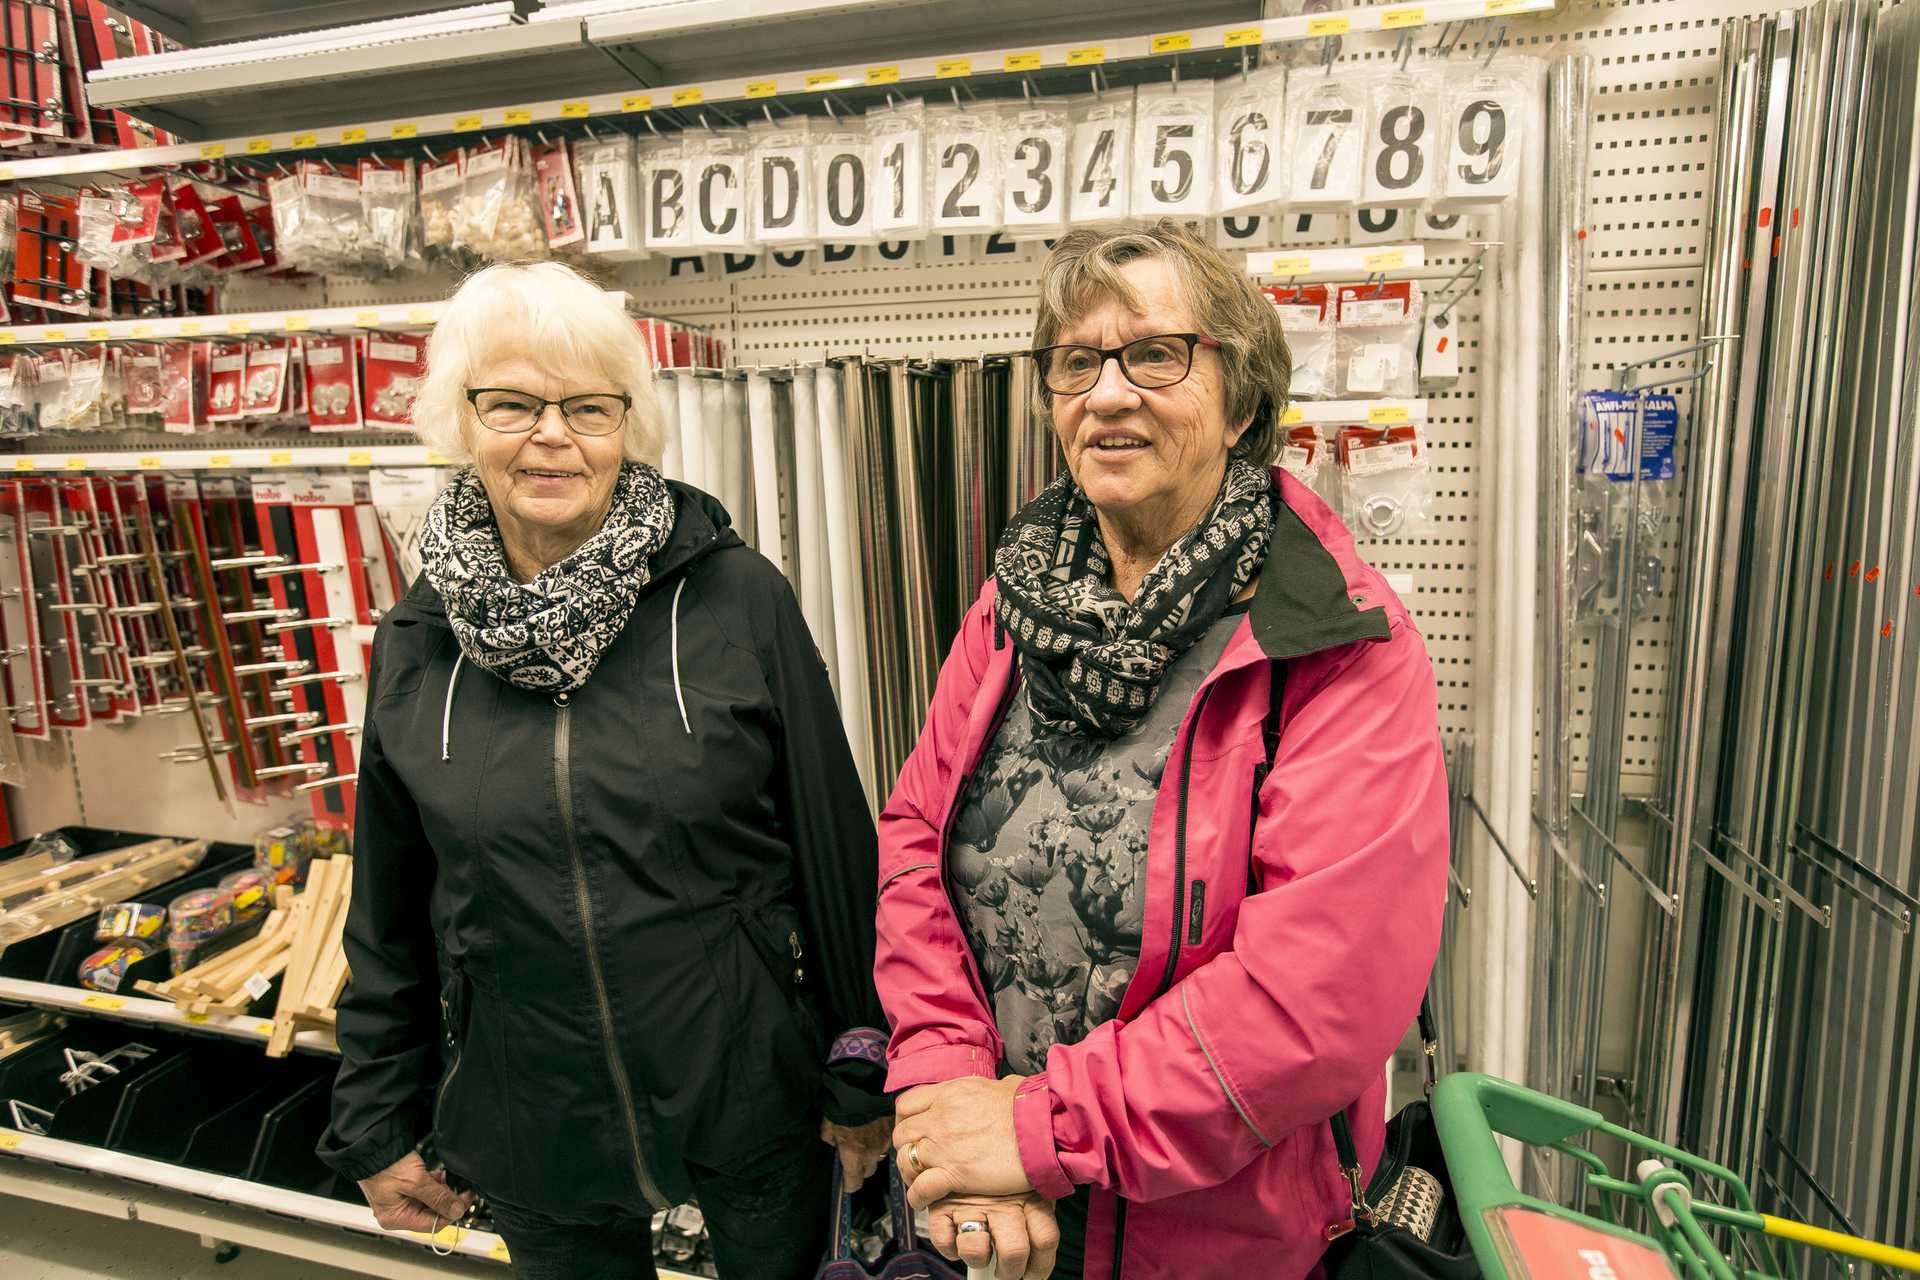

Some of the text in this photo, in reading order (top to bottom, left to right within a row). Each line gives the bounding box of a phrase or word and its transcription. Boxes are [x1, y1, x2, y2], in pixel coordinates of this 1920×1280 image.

[882, 142, 905, 219] 1
[941, 143, 981, 219] 2
[1012, 136, 1053, 214] 3
[1079, 129, 1117, 208] 4
[1150, 125, 1194, 204] 5
[1229, 111, 1271, 197] 6
[1306, 109, 1353, 190] 7
[1375, 105, 1425, 190] 8
[1457, 100, 1507, 185] 9
[591, 170, 623, 242] A
[651, 168, 685, 240] B
[699, 163, 738, 235] C
[762, 154, 800, 229] D
[293, 490, 326, 503] habo
